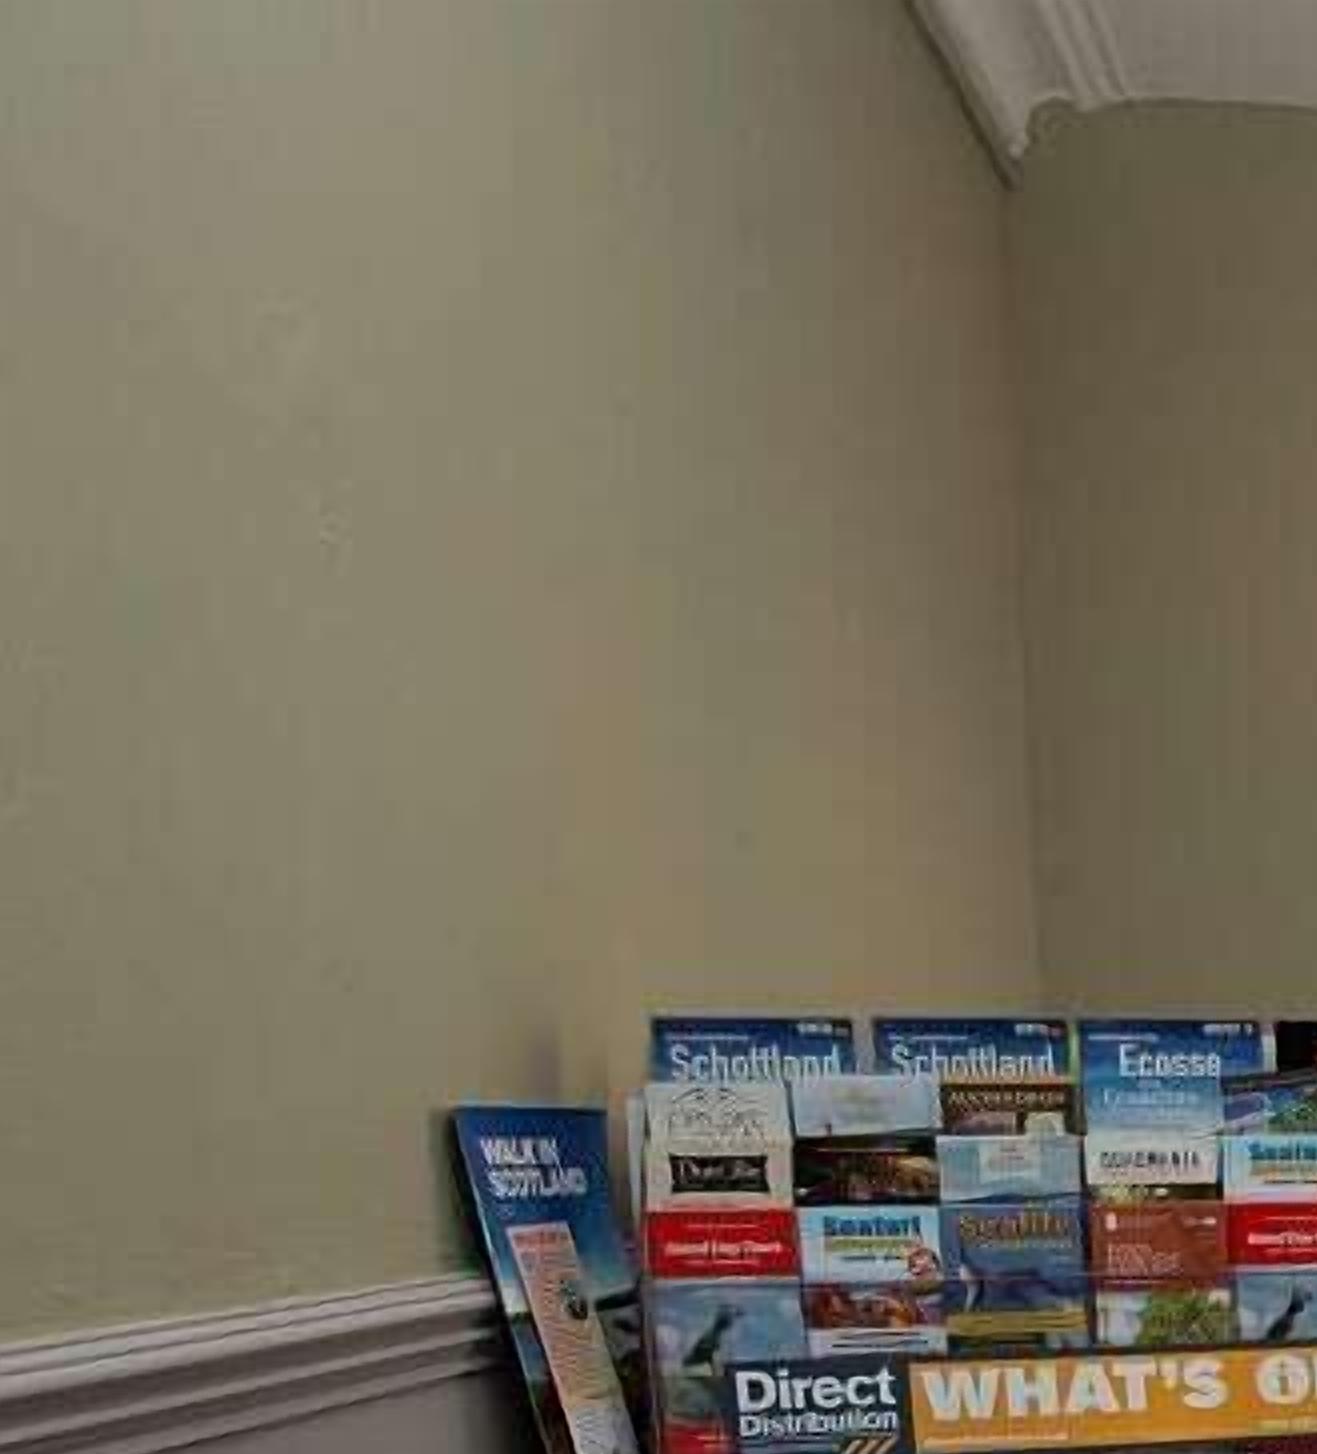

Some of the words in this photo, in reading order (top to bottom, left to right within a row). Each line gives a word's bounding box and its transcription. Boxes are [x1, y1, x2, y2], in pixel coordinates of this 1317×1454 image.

[734, 1364, 897, 1414] Direct
[920, 1355, 1228, 1422] WHAT'S
[738, 1409, 899, 1438] Distribution
